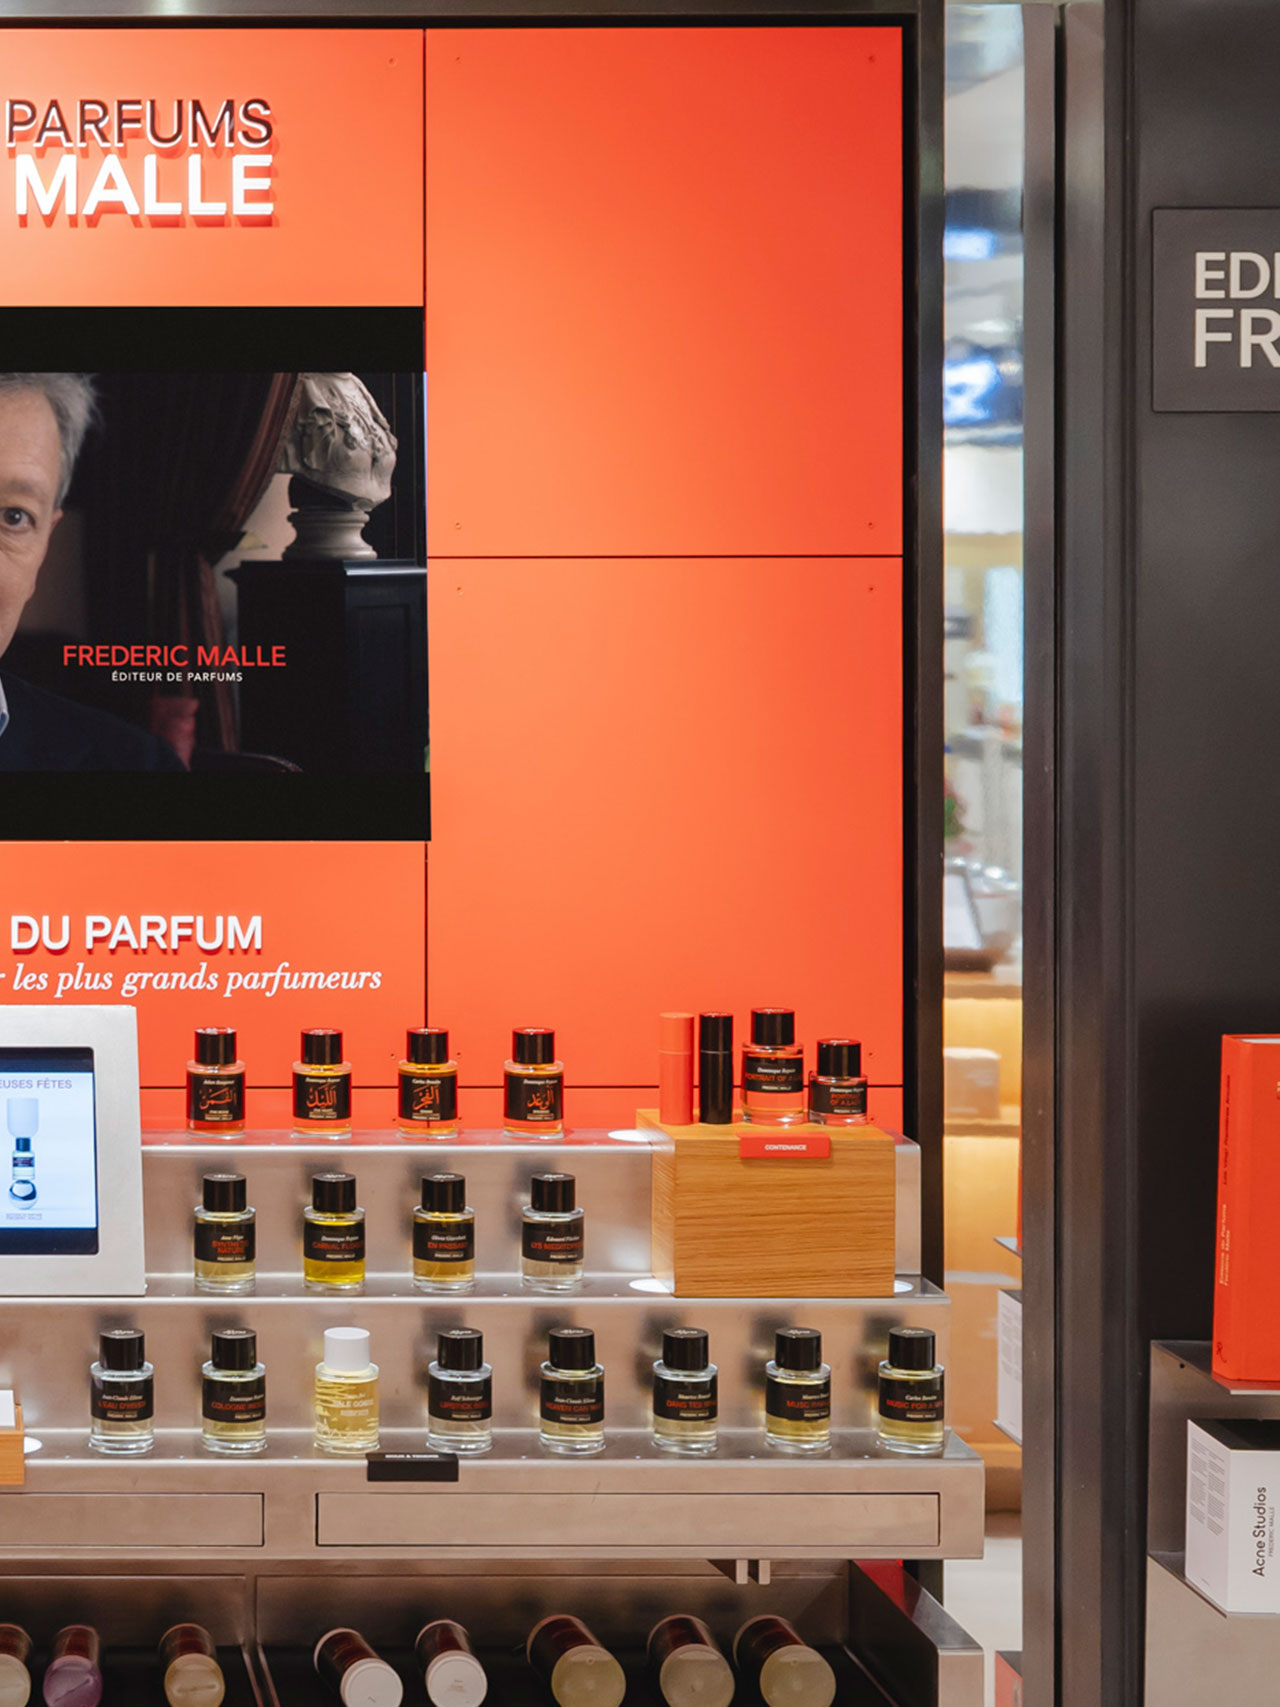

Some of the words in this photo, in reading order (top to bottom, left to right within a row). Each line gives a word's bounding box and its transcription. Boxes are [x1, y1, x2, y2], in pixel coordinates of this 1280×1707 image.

[6, 99, 273, 148] PARFUMS
[15, 154, 274, 217] MALLE
[63, 645, 189, 667] FREDERIC
[197, 645, 287, 667] MALLE
[111, 670, 163, 682] ÉDITEUR
[166, 671, 183, 682] DE
[187, 671, 243, 682] PARFUMS
[10, 914, 70, 950] DU
[85, 914, 262, 950] PARFUM
[13, 962, 48, 991] les
[54, 962, 114, 998] plus
[120, 961, 219, 998] grands
[223, 961, 382, 998] parfumeurs
[1252, 1487, 1267, 1538] Studios
[1251, 1540, 1266, 1577] Acne
